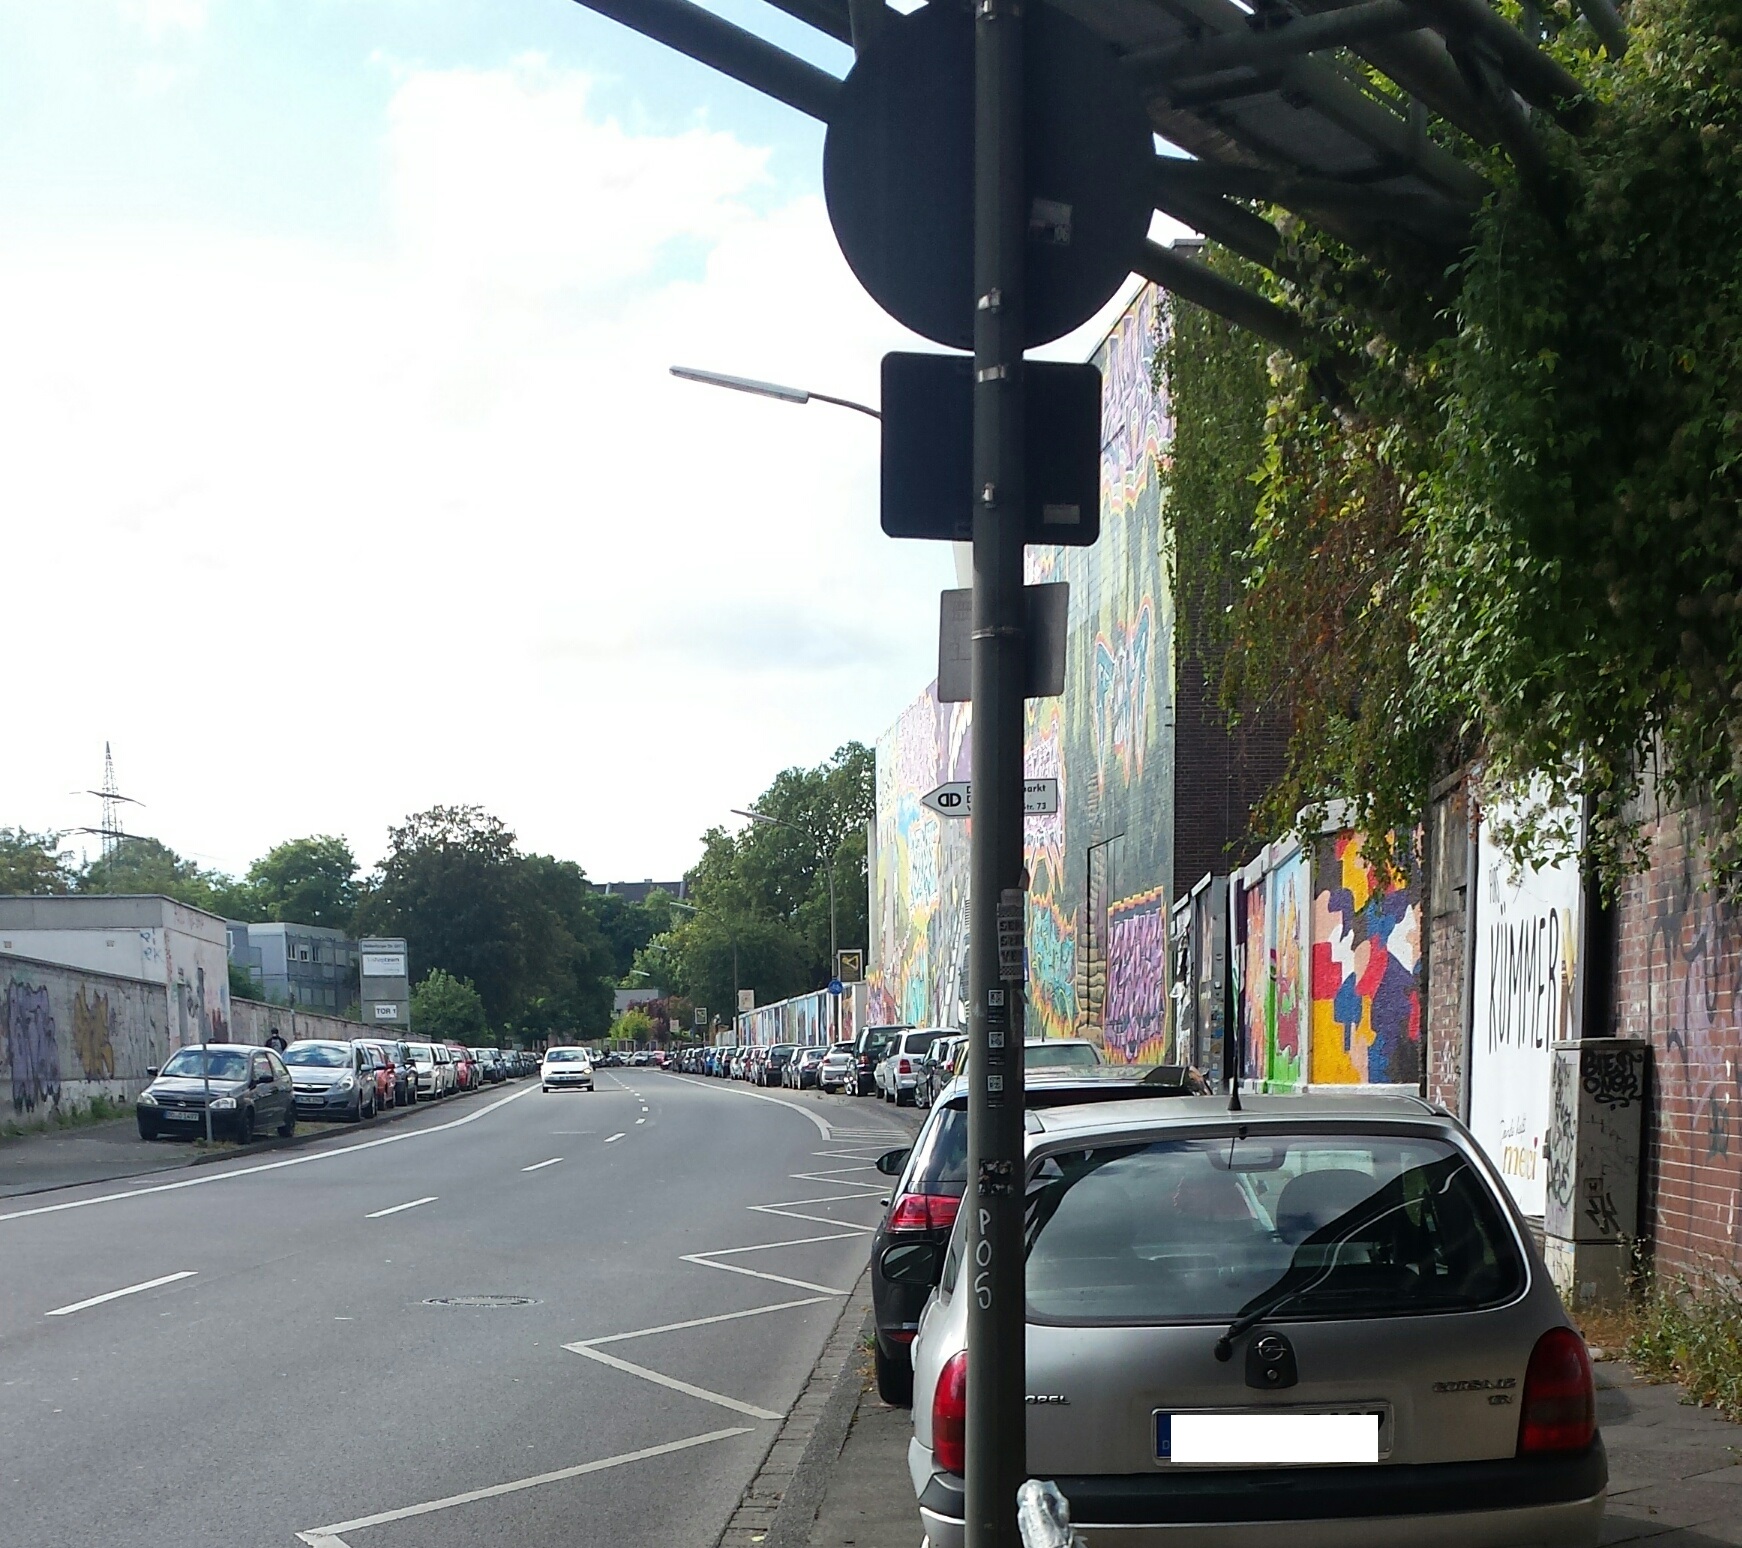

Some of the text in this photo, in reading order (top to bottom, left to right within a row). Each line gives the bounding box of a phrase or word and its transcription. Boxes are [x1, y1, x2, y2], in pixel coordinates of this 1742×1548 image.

[1037, 802, 1046, 810] 73
[376, 1007, 391, 1015] TOR
[1024, 1394, 1071, 1405] OPEL
